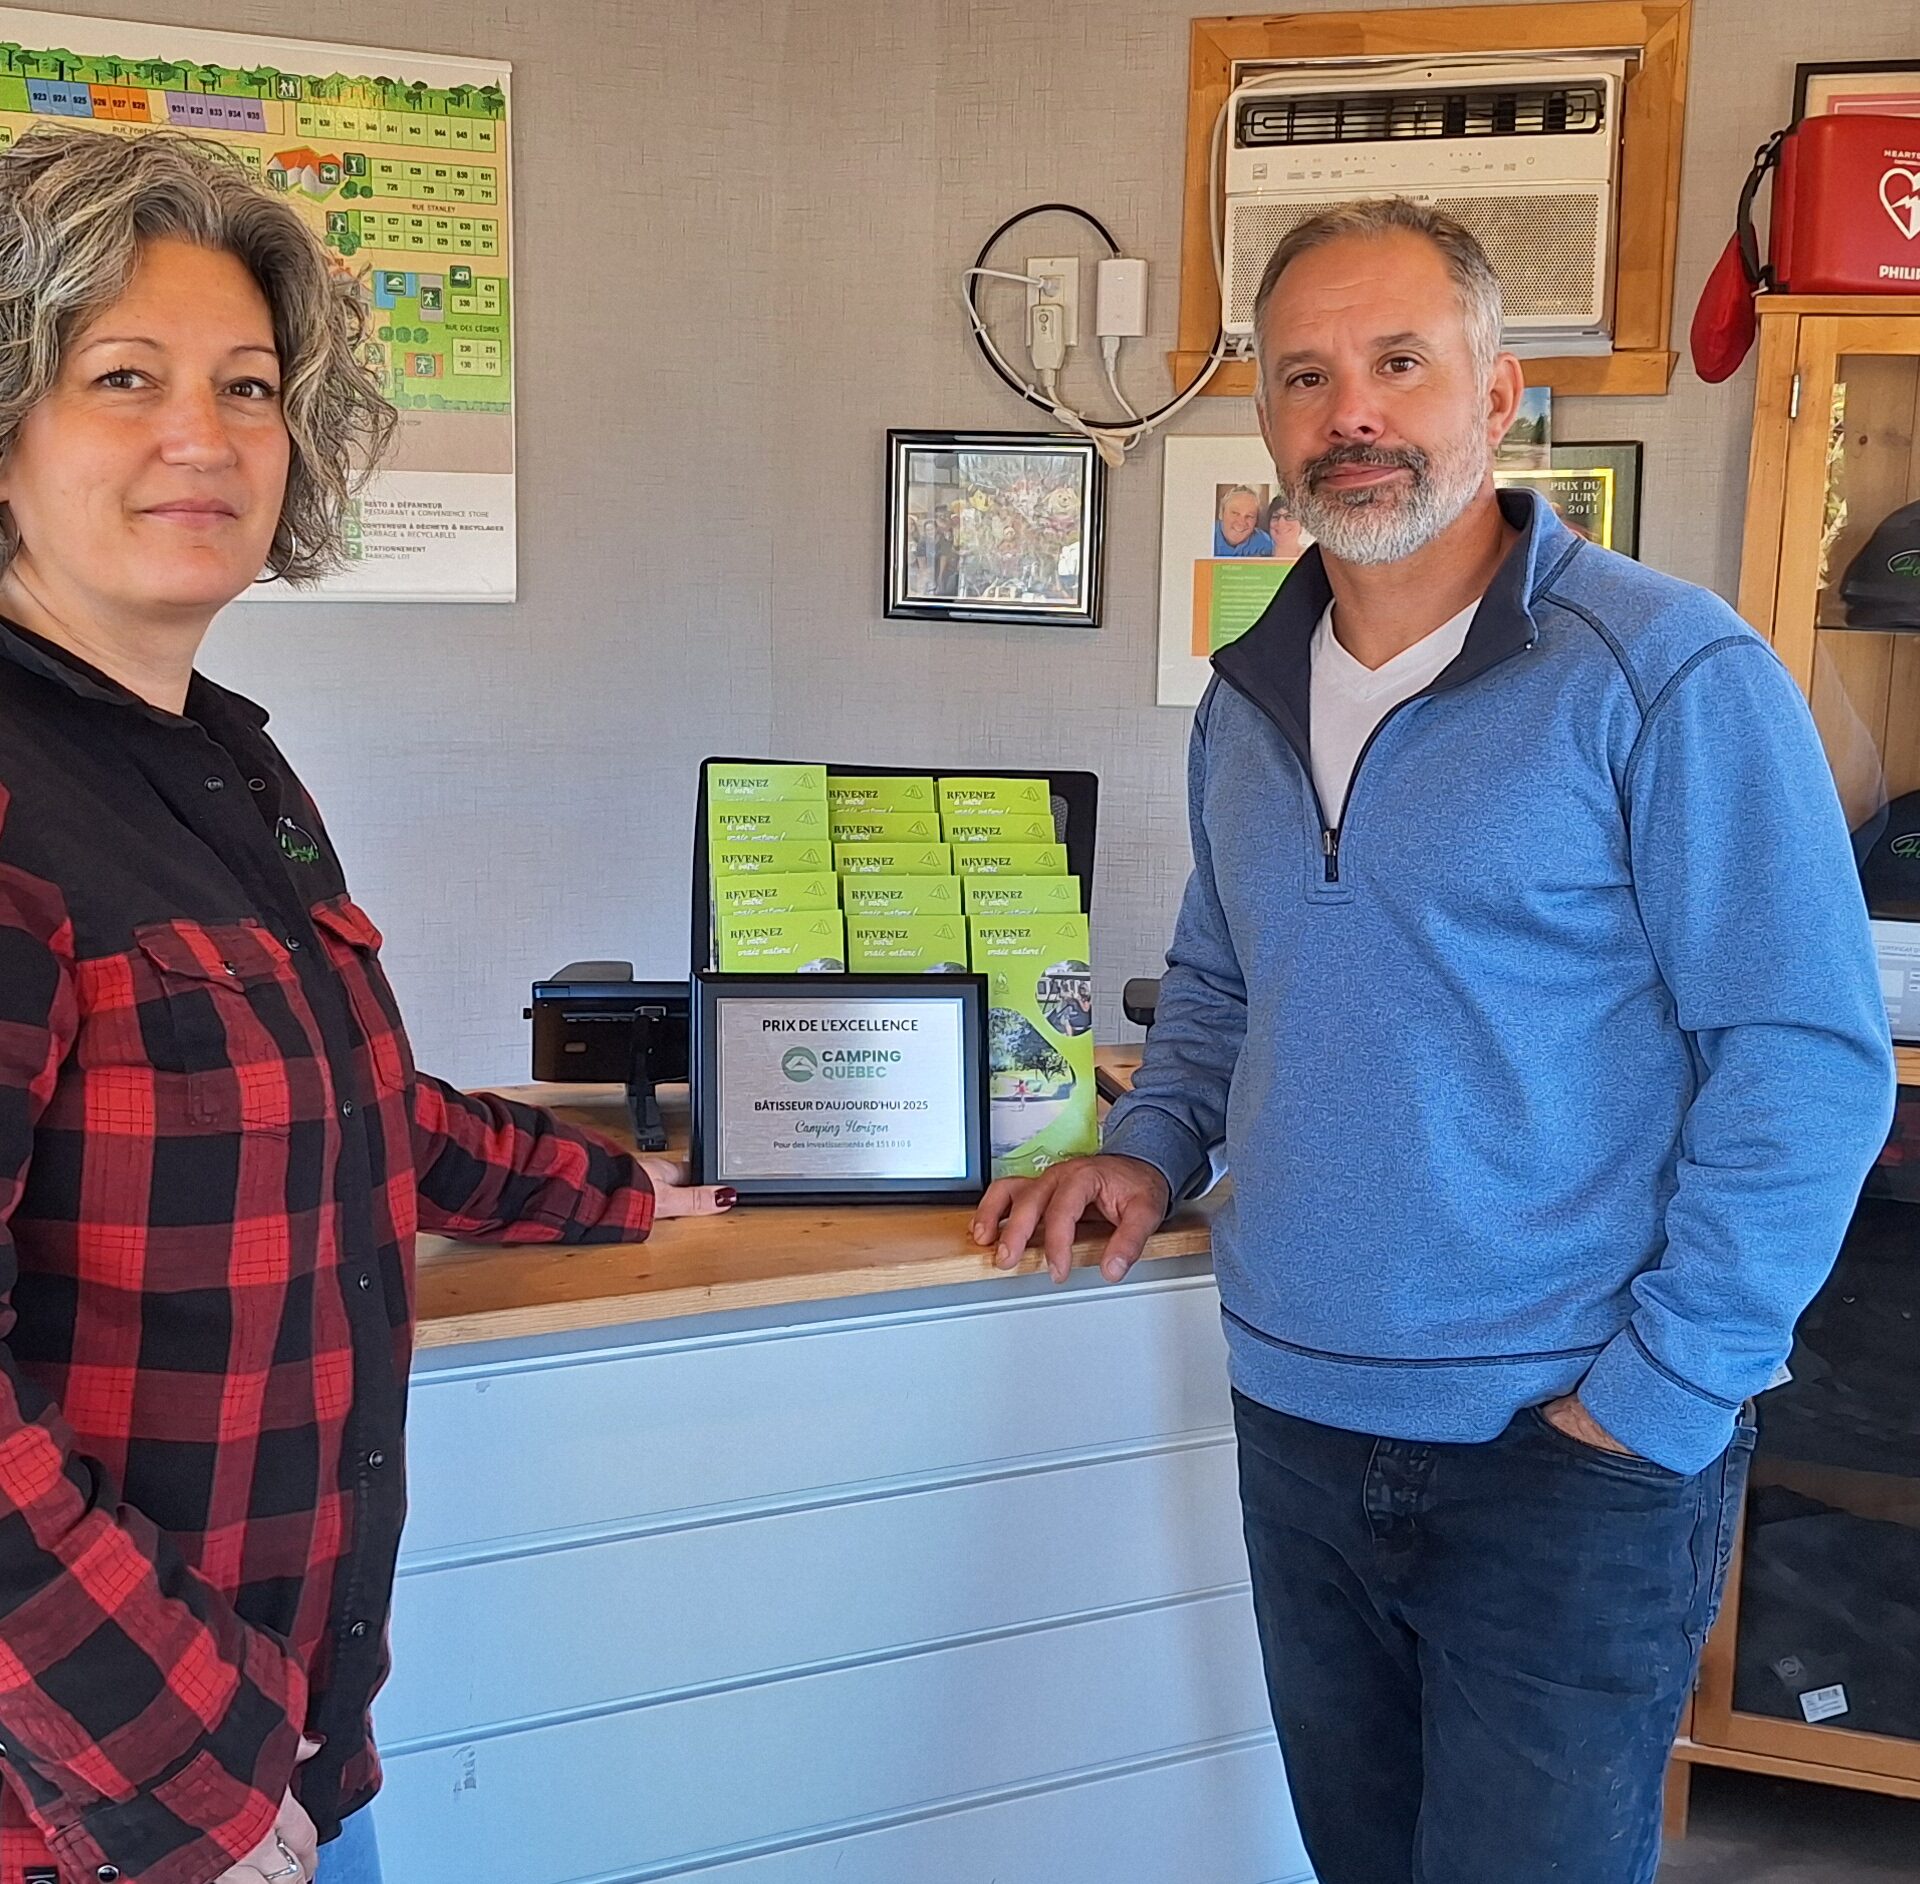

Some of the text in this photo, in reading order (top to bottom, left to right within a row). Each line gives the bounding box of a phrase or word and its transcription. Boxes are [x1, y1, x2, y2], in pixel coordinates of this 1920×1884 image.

[247, 111, 260, 120] 935
[386, 125, 398, 133] 941
[428, 205, 455, 213] STANLEY
[1550, 481, 1600, 490] PRIX DU
[1568, 493, 1599, 502] JURY
[1568, 505, 1598, 513] 2011
[718, 778, 768, 788] REVENEZ
[829, 790, 878, 799] REVENEZ
[947, 791, 995, 799] REVENEZ
[719, 815, 771, 824] REVENEZ
[834, 826, 883, 834] REVENEZ
[952, 827, 1002, 835] REVENEZ
[721, 855, 774, 864] REVENEZ
[843, 857, 894, 866] REVENEZ
[962, 858, 1011, 866] REVENEZ
[726, 889, 778, 900] REVENEZ
[852, 891, 903, 899] REVENEZ
[972, 890, 1023, 899] REVENEZ
[730, 928, 783, 939] REVENEZ
[857, 930, 908, 939] REVENEZ
[980, 929, 1031, 937] REVENEZ
[762, 1019, 919, 1032] PRIX DE L'EXCELLENCE
[822, 1050, 901, 1063] CAMPING
[822, 1062, 887, 1079] QUÉBEC
[754, 1099, 928, 1111] BÂTISSEUR D'AUJOURD'HUI 2025
[795, 1120, 889, 1138] Camping Horizon
